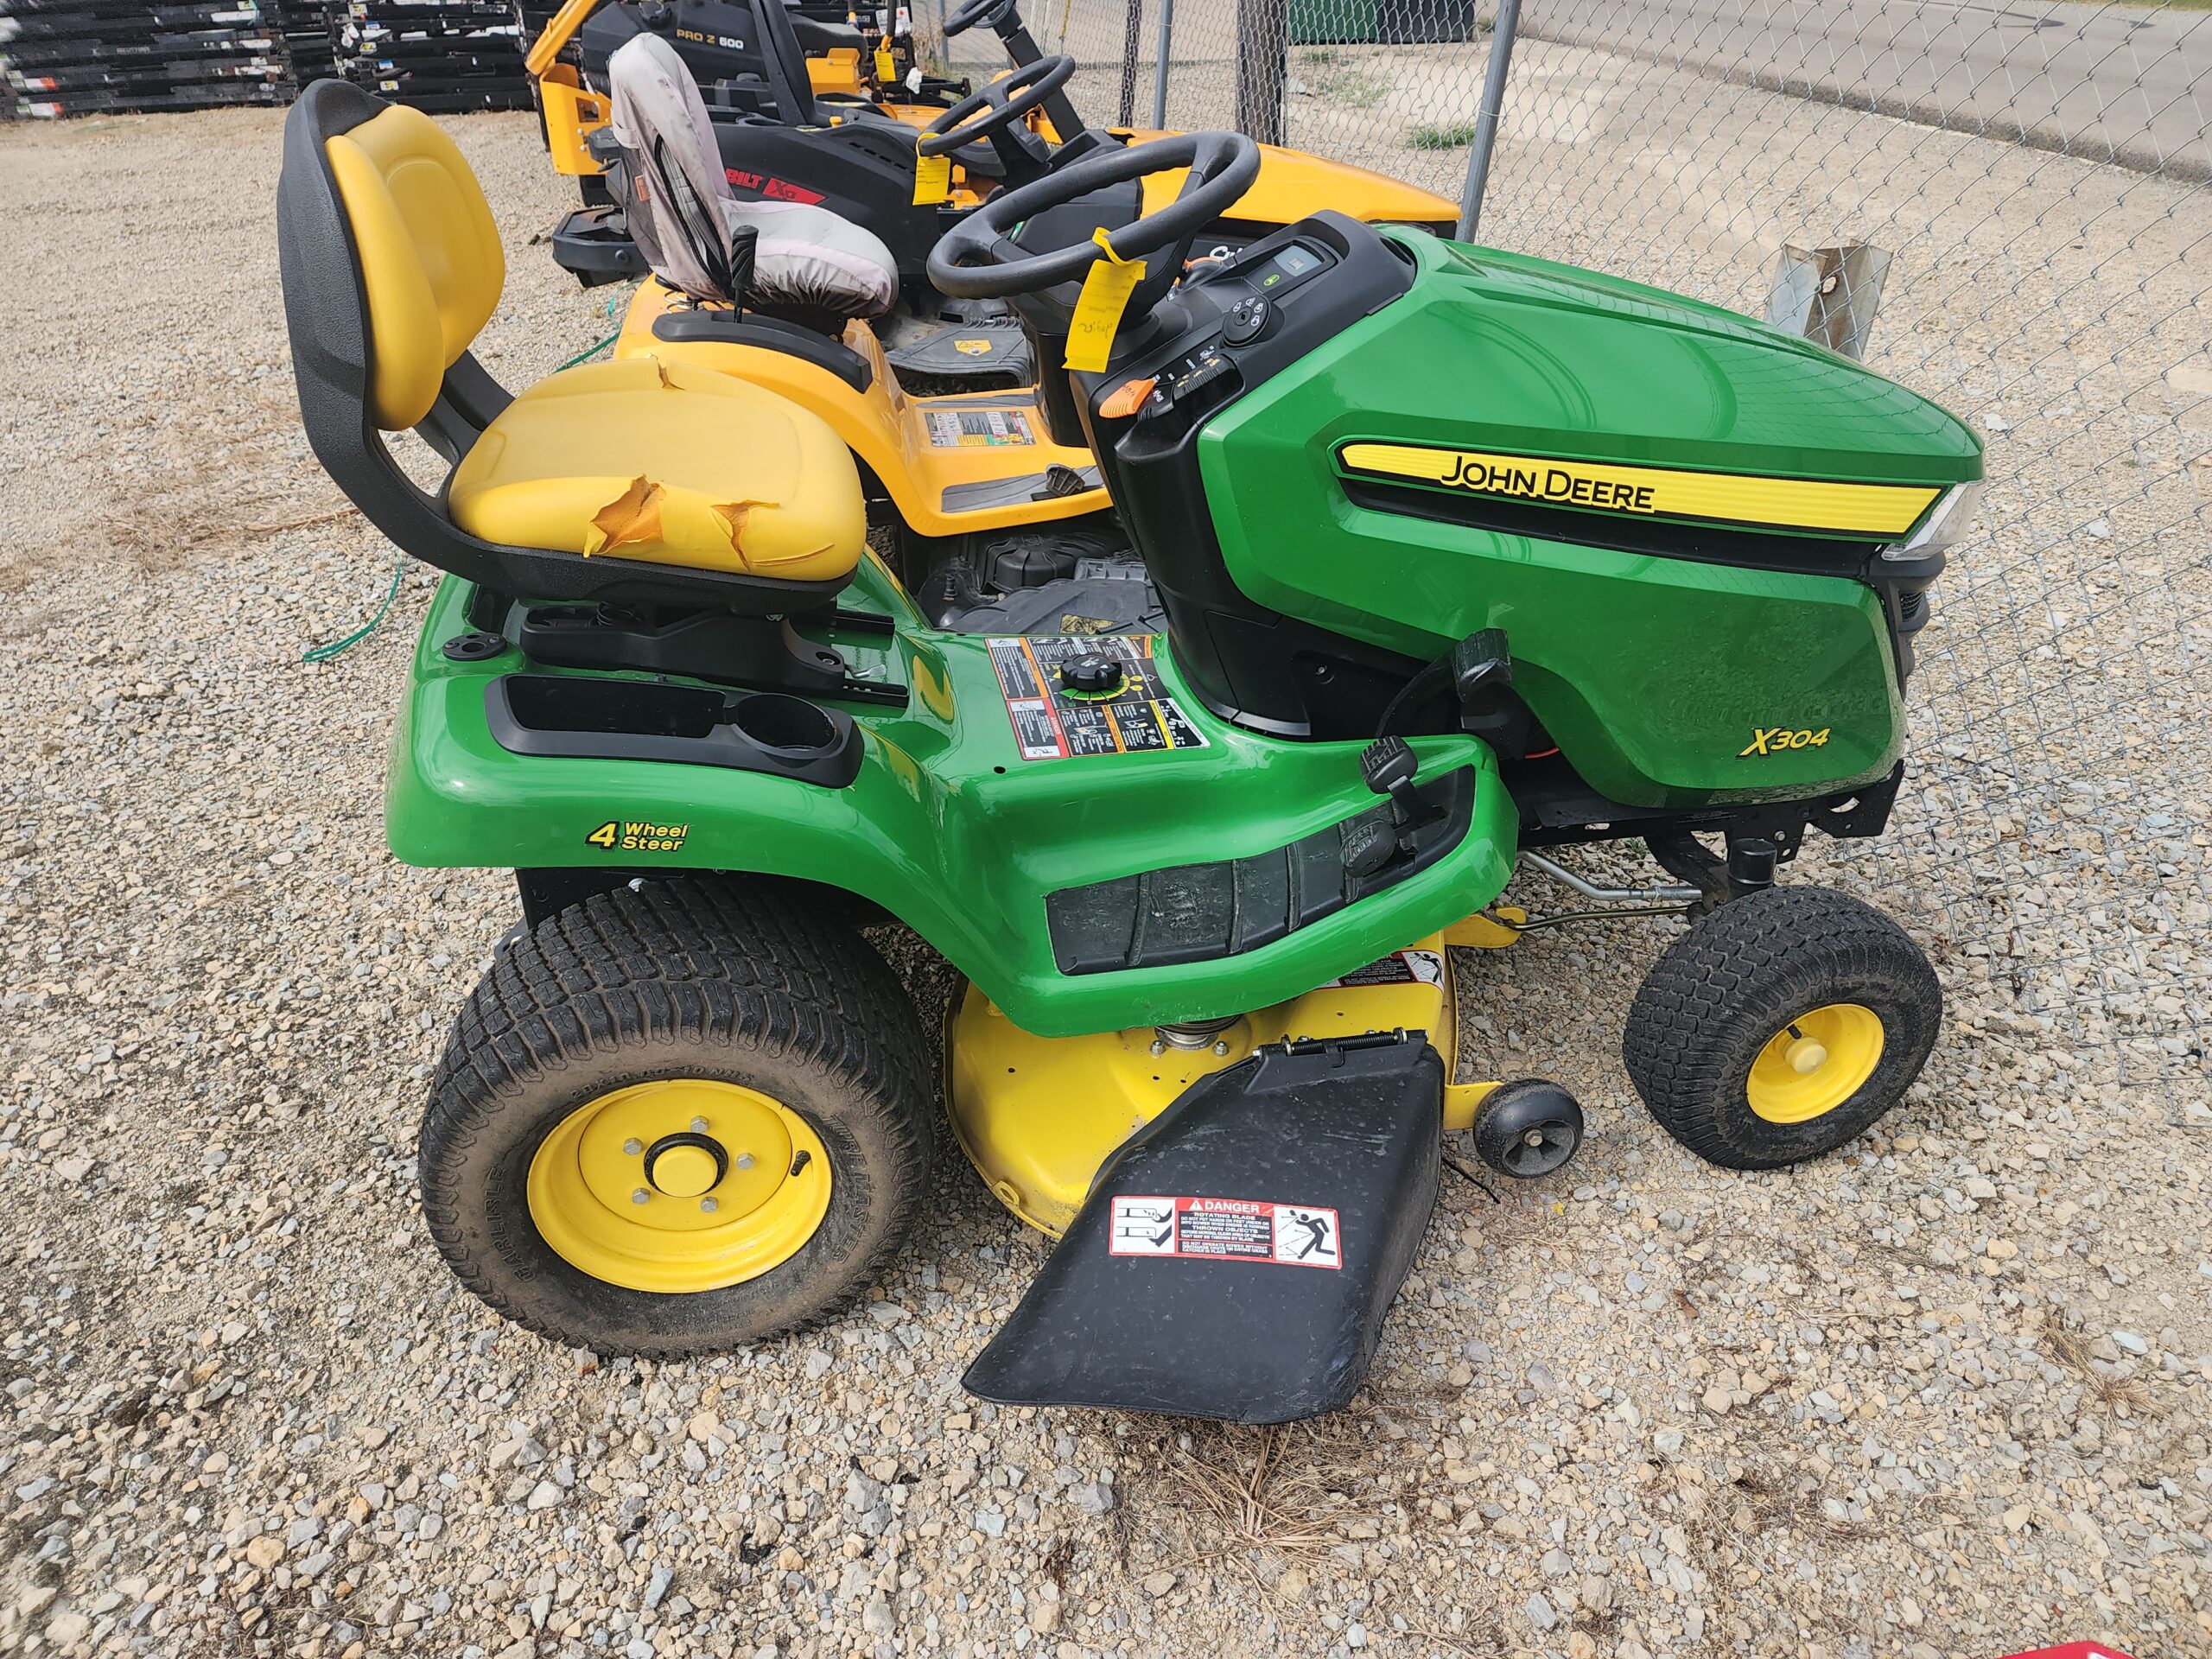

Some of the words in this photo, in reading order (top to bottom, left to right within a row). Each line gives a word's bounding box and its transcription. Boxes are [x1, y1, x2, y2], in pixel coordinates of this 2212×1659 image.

[677, 29, 703, 42] PRO
[706, 35, 715, 44] Z
[1441, 455, 1536, 493] JOHN
[1544, 468, 1655, 510] DEERE
[1737, 728, 1831, 757] X304
[588, 822, 618, 849] 4
[625, 823, 689, 838] Wheel
[621, 836, 683, 851] Steer
[833, 1172, 871, 1263] MASTER
[1205, 1201, 1260, 1213] DANGER
[485, 1166, 537, 1283] CARLISLE
